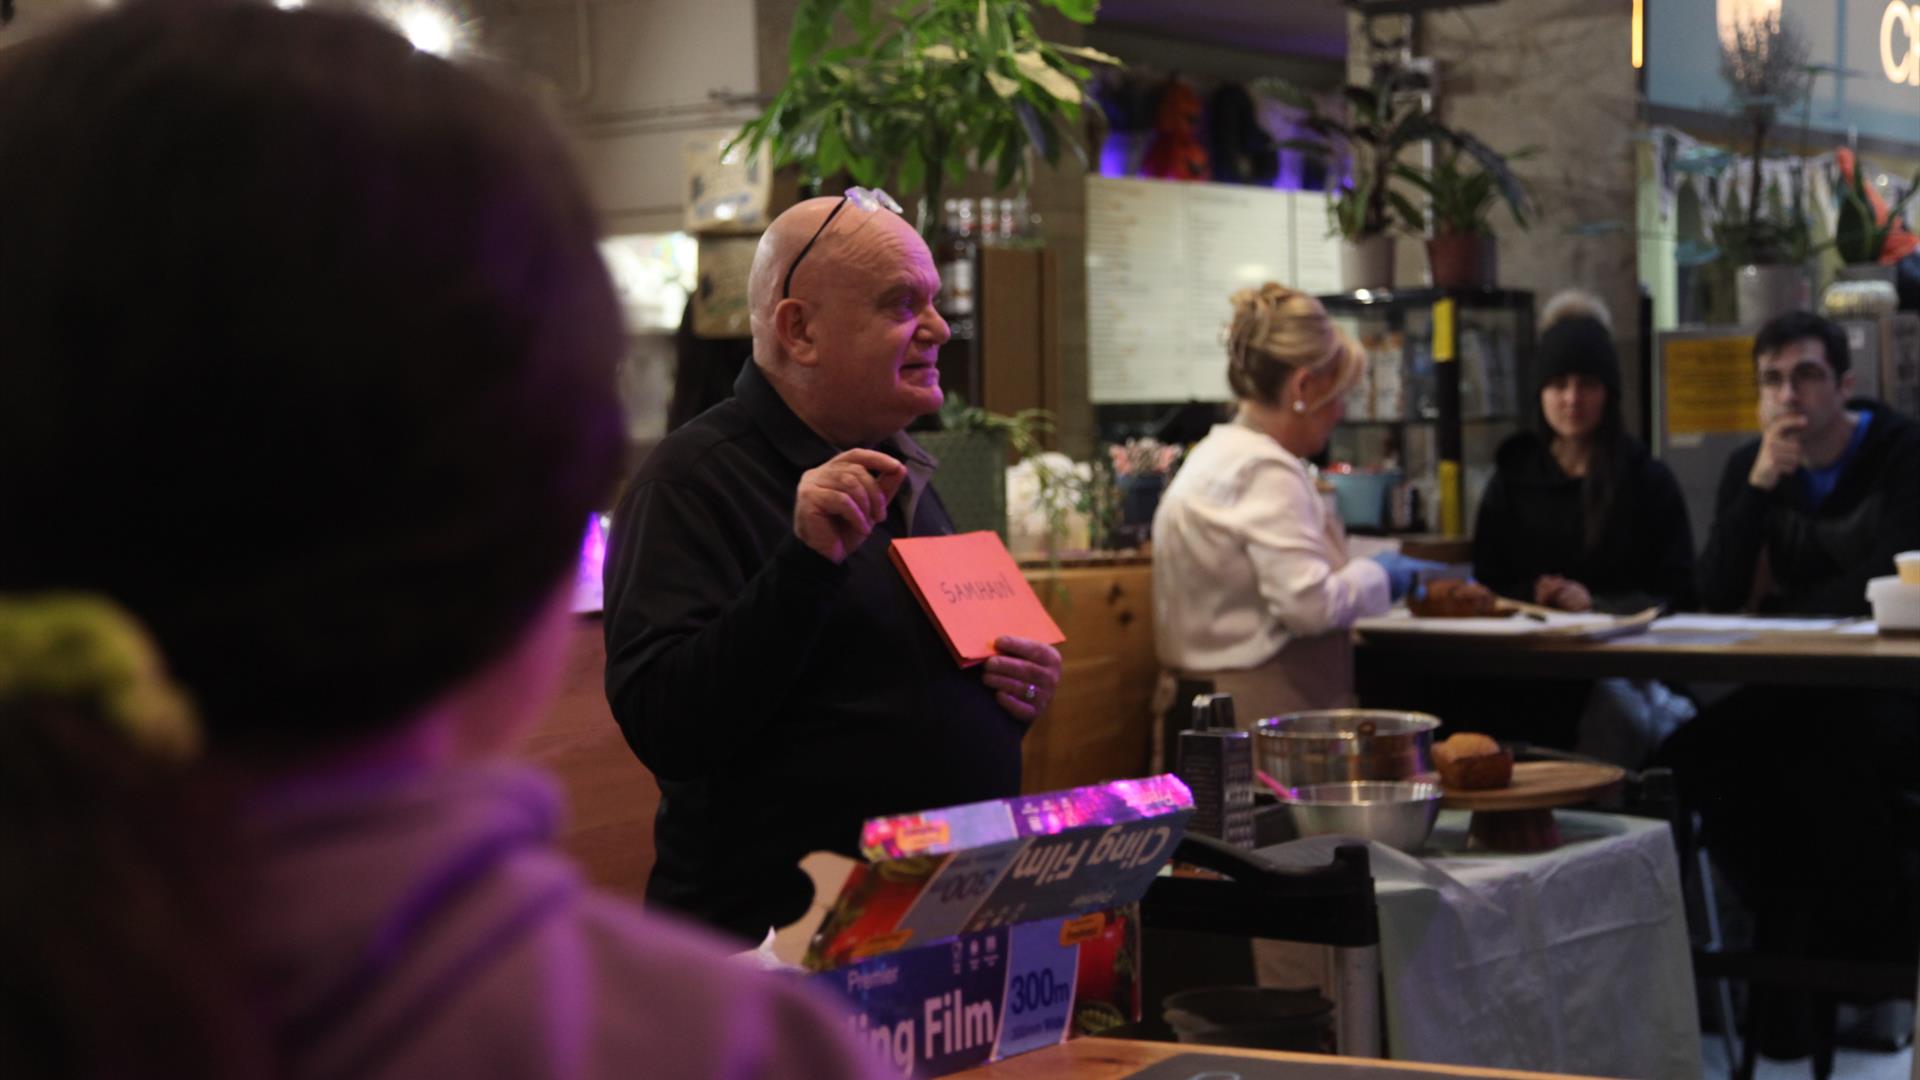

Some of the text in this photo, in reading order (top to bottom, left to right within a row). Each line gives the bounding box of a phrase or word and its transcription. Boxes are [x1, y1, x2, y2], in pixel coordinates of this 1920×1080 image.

[940, 572, 1015, 603] SAMHAIN
[1012, 824, 1171, 887] Cling Film
[1010, 967, 1070, 1014] 300m
[847, 988, 995, 1080] ing Film
